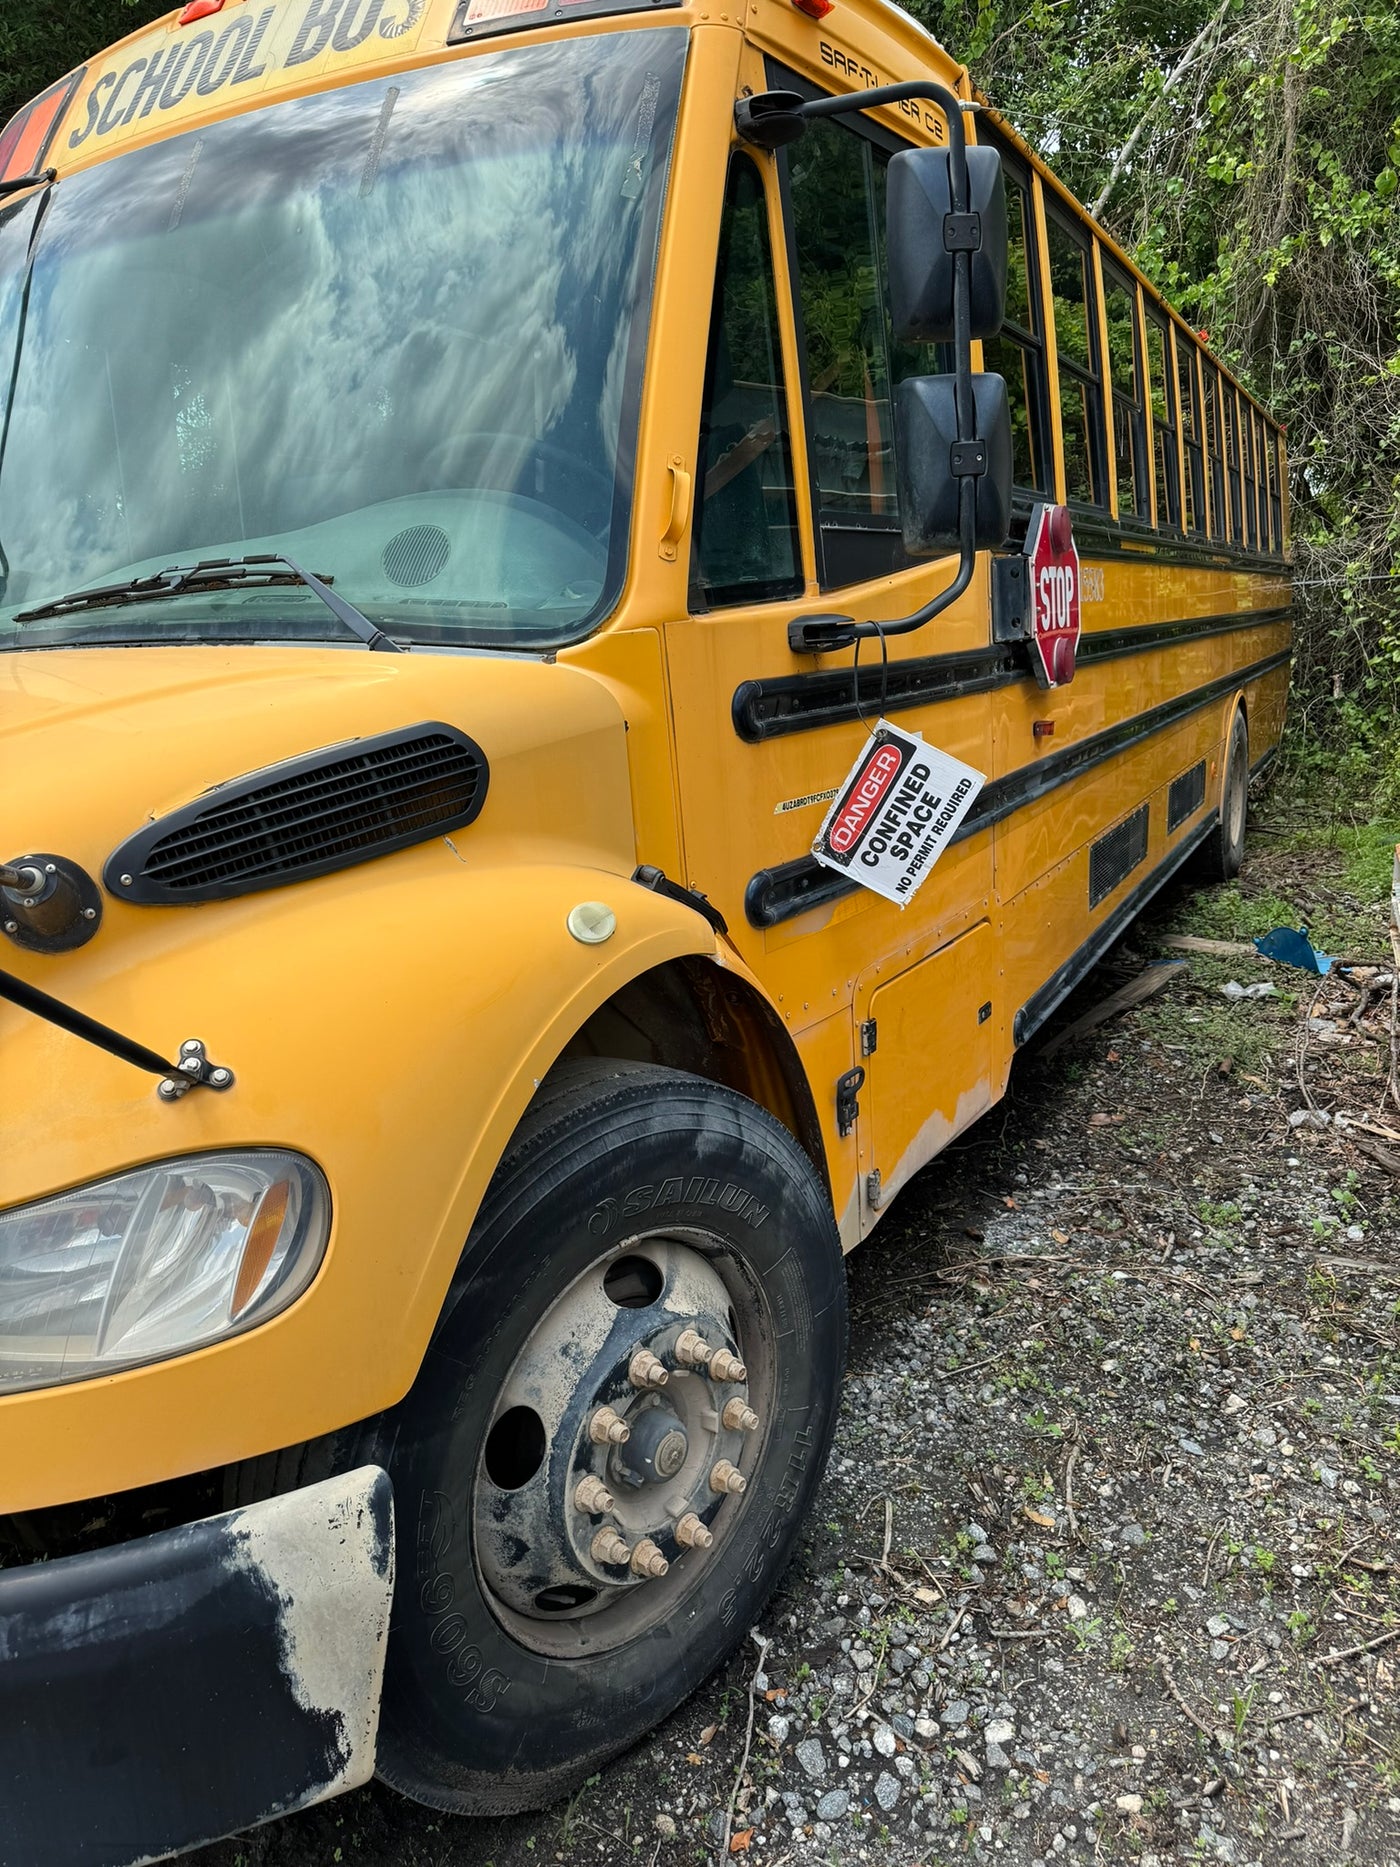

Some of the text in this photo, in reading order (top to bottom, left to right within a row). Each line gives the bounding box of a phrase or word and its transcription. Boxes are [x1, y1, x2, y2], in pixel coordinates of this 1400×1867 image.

[68, 4, 277, 150] SCHOOL
[924, 112, 944, 142] C2
[1039, 565, 1074, 631] STOP
[834, 752, 897, 847] DANGER
[860, 763, 931, 867] CONFINED
[890, 791, 942, 861] SPACE
[895, 778, 972, 894] NO PERMIT REQUIRED
[621, 1176, 772, 1230] SAILUN
[419, 1571, 512, 1714] S606
